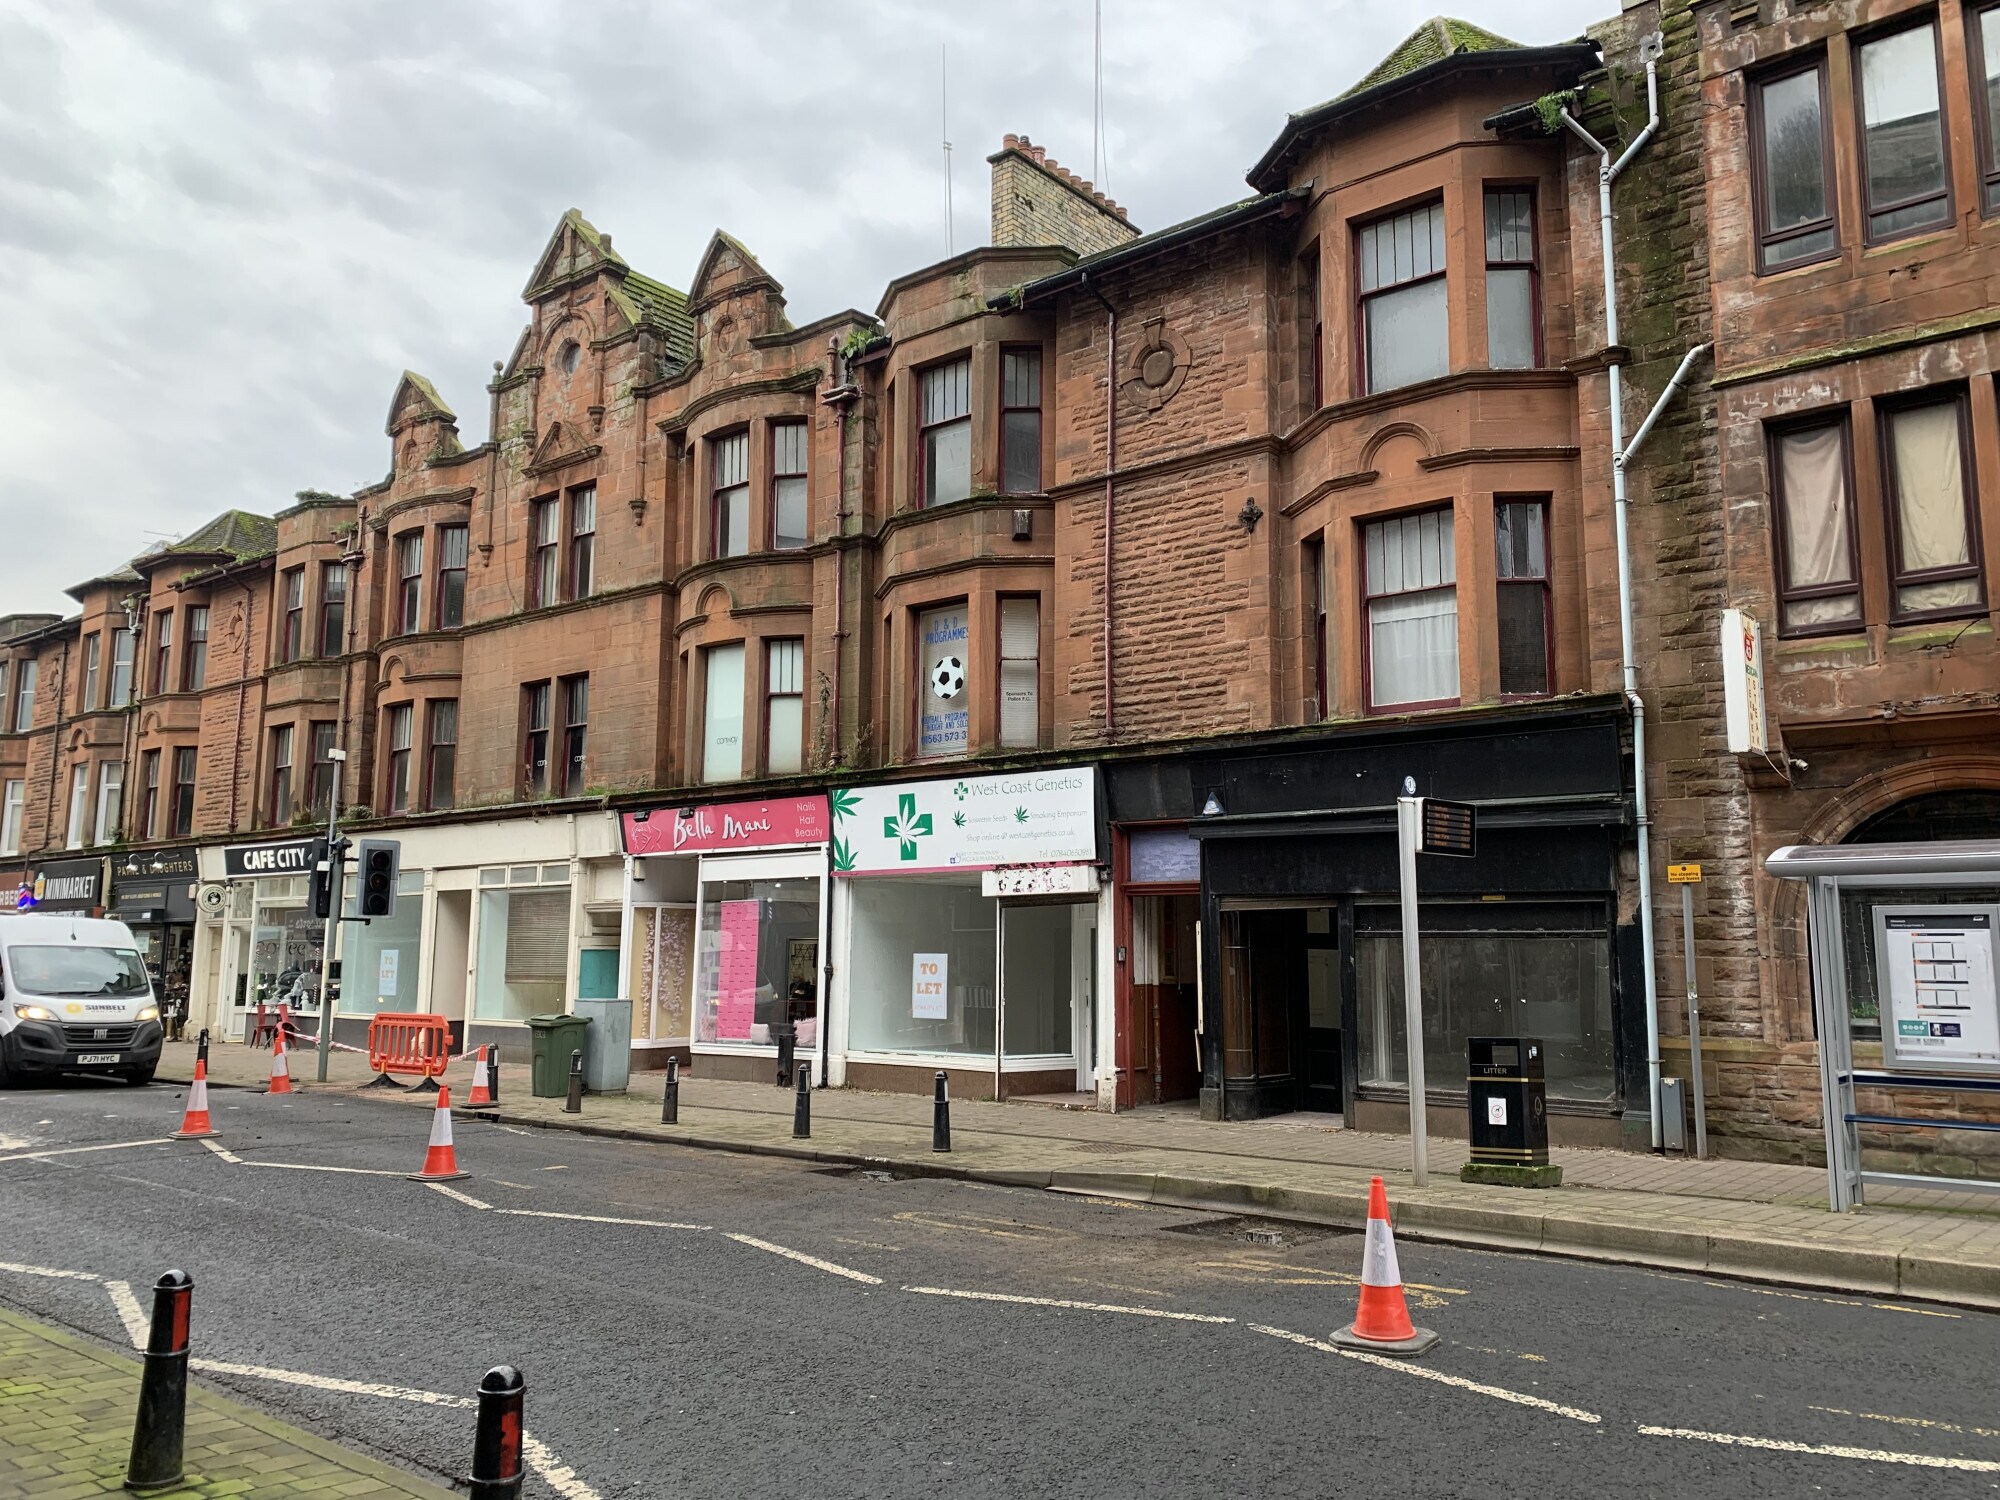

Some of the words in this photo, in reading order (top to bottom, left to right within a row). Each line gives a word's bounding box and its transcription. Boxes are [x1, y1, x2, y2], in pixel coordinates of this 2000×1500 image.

[944, 618, 949, 630] &
[945, 721, 954, 729] AND
[944, 732, 959, 742] 573
[971, 782, 999, 797] West
[1001, 780, 1031, 795] Coast
[1035, 776, 1083, 792] Genetics
[796, 801, 816, 812] Nails
[799, 814, 815, 825] Hair
[1030, 811, 1056, 821] Smoking
[673, 810, 714, 850] Bella
[721, 807, 772, 840] Mani
[794, 826, 823, 839] Beauty
[966, 832, 980, 843] Shop
[981, 831, 1000, 841] online
[243, 849, 275, 870] CAFE
[277, 848, 305, 868] CITY
[142, 860, 147, 875] &
[149, 860, 193, 874] DUGHTERS
[45, 875, 96, 900] MINIMARKET
[256, 936, 306, 956] coee
[920, 962, 938, 975] TO
[916, 982, 942, 995] LET
[93, 1029, 108, 1039] FIAT
[1483, 1067, 1508, 1075] LITTER
